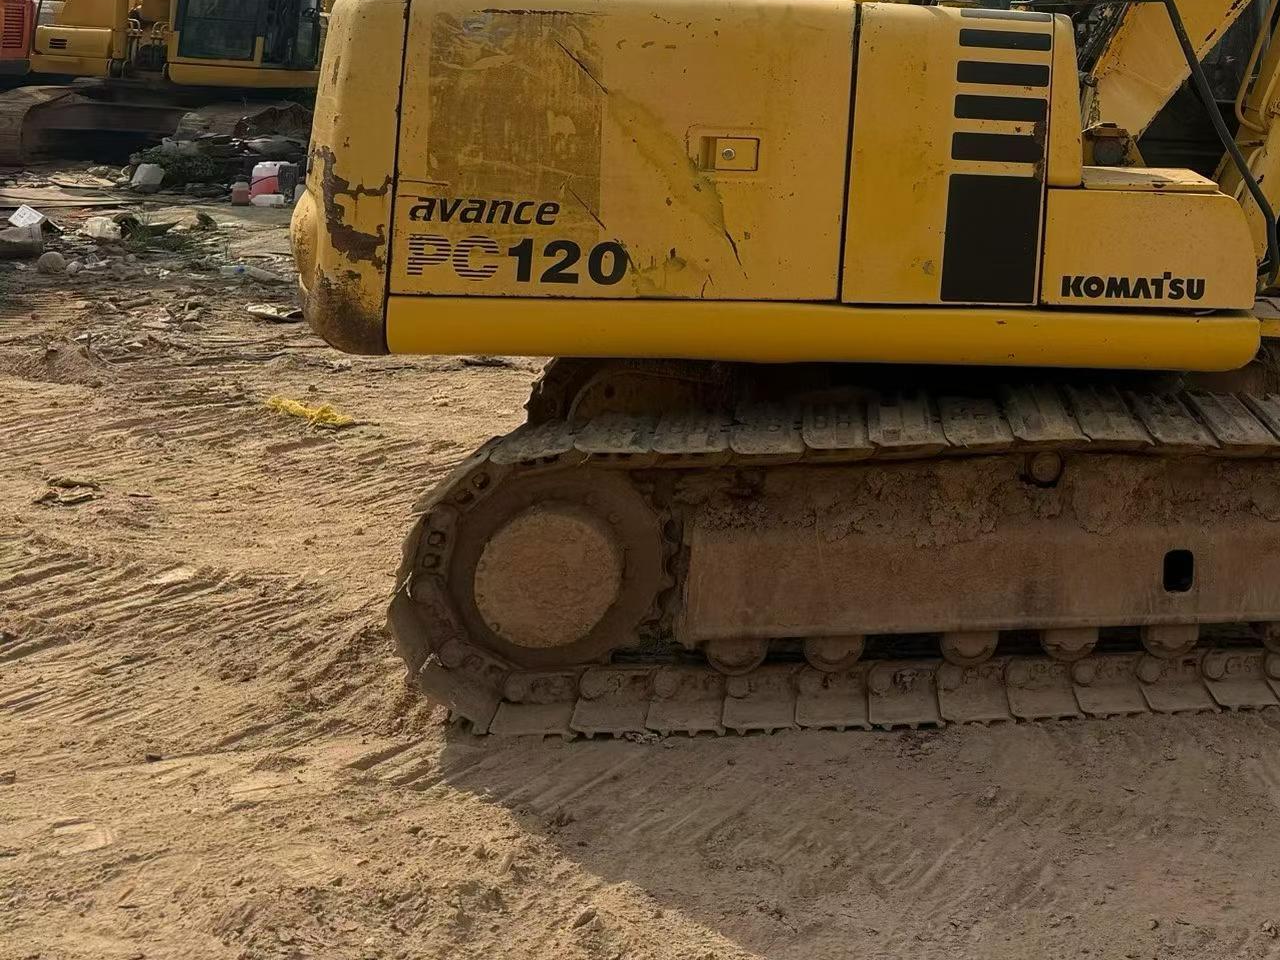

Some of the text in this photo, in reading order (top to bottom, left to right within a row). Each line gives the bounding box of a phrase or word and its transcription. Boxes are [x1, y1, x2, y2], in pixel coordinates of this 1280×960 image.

[408, 196, 561, 226] avance
[406, 233, 629, 287] PC120
[1061, 271, 1206, 301] KOMATSU
